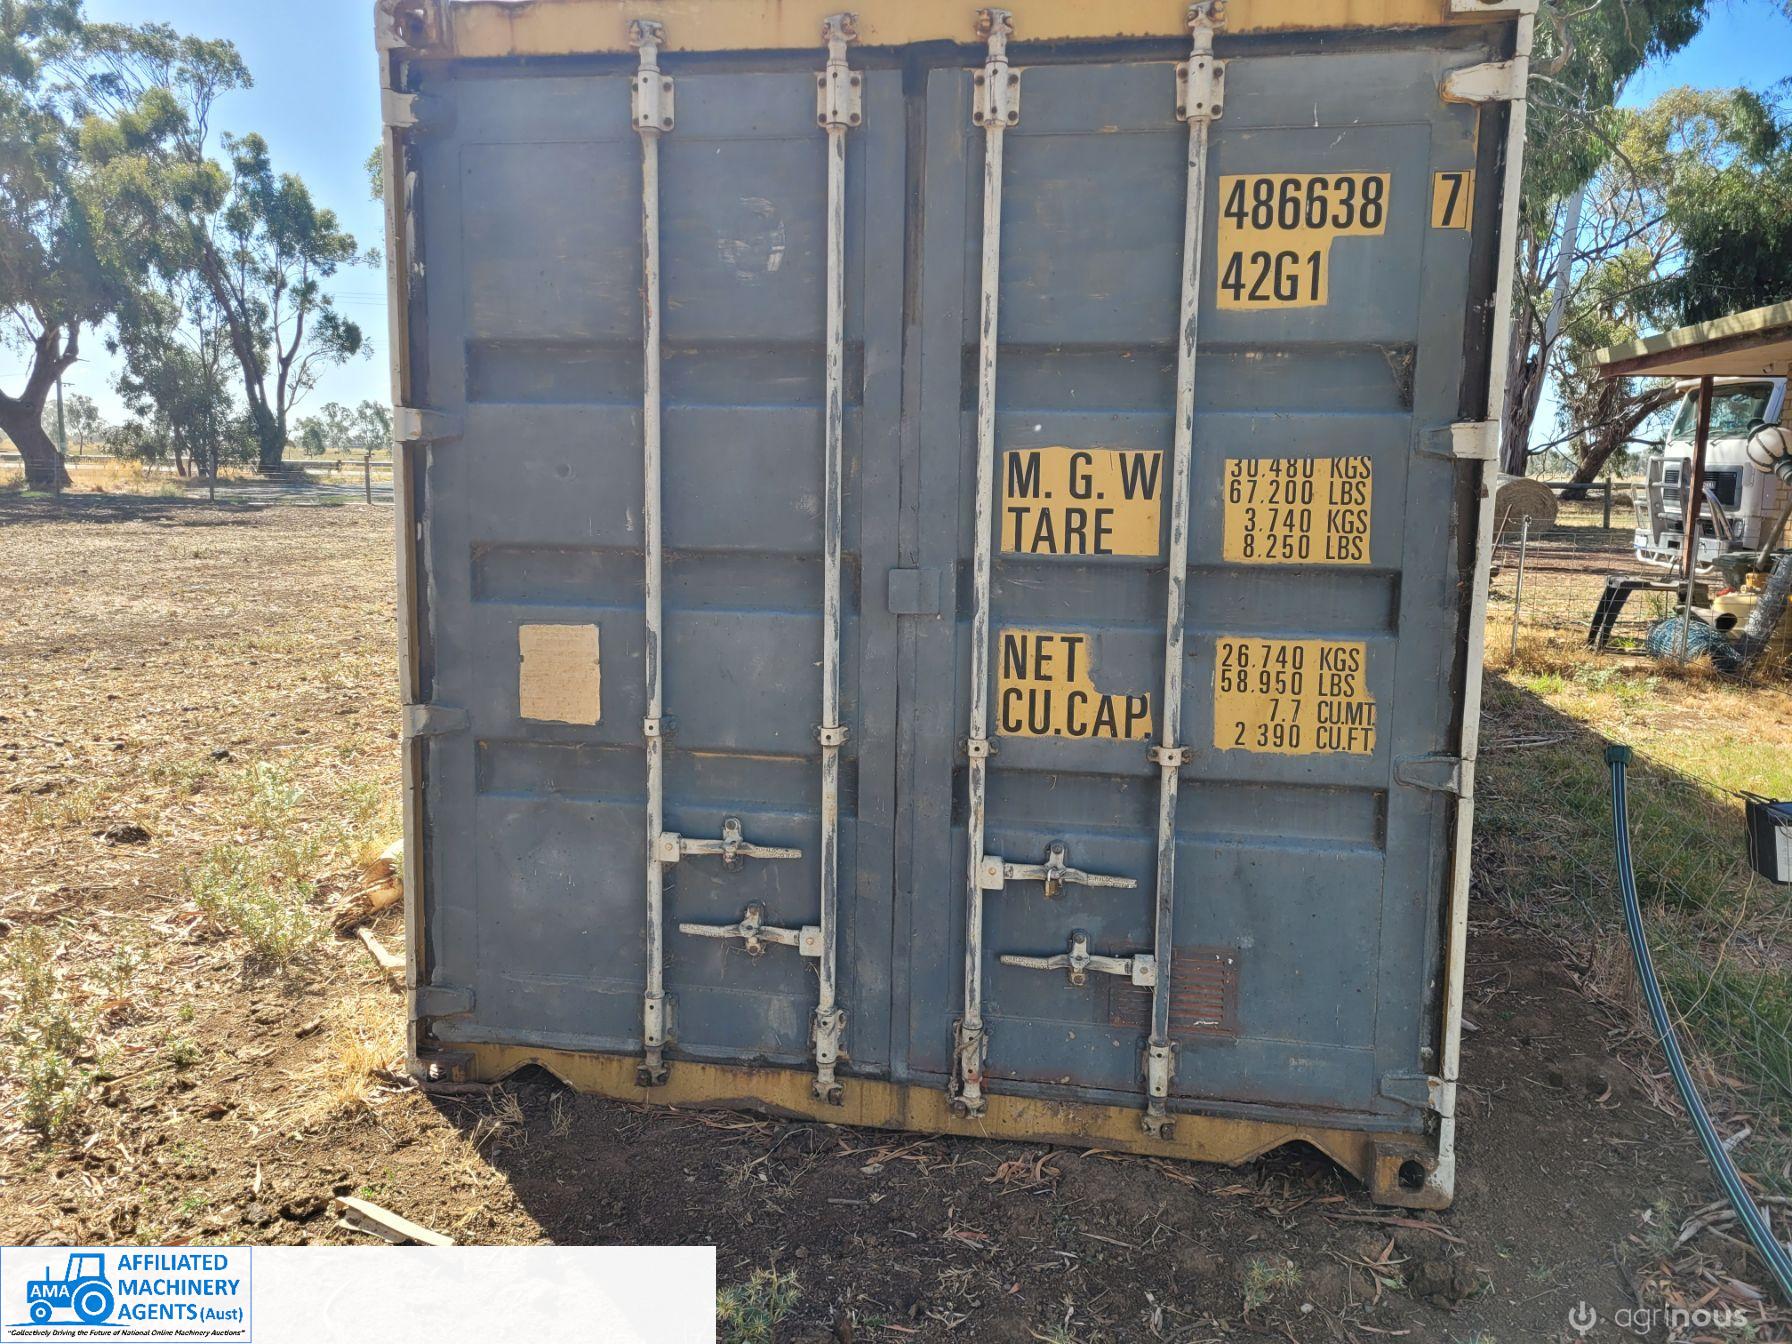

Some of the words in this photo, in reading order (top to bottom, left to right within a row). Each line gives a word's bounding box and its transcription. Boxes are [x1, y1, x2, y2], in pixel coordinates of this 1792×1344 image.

[1224, 176, 1384, 230] 486638
[1441, 173, 1463, 227] 7
[1221, 250, 1322, 301] 42G1
[1330, 456, 1371, 480] KGS
[1229, 479, 1314, 505] 67.200
[1328, 480, 1367, 506] LBS
[1007, 506, 1115, 555] TARE
[1244, 507, 1312, 534] 3.740
[1327, 509, 1368, 535] KGS
[1242, 533, 1311, 559] 8.250
[1325, 535, 1364, 561] LBS
[1003, 634, 1084, 683] NET
[1221, 643, 1305, 671] 26.740
[1319, 646, 1361, 673] KGS
[1220, 668, 1304, 696] 58.950
[1318, 672, 1356, 698] LBS
